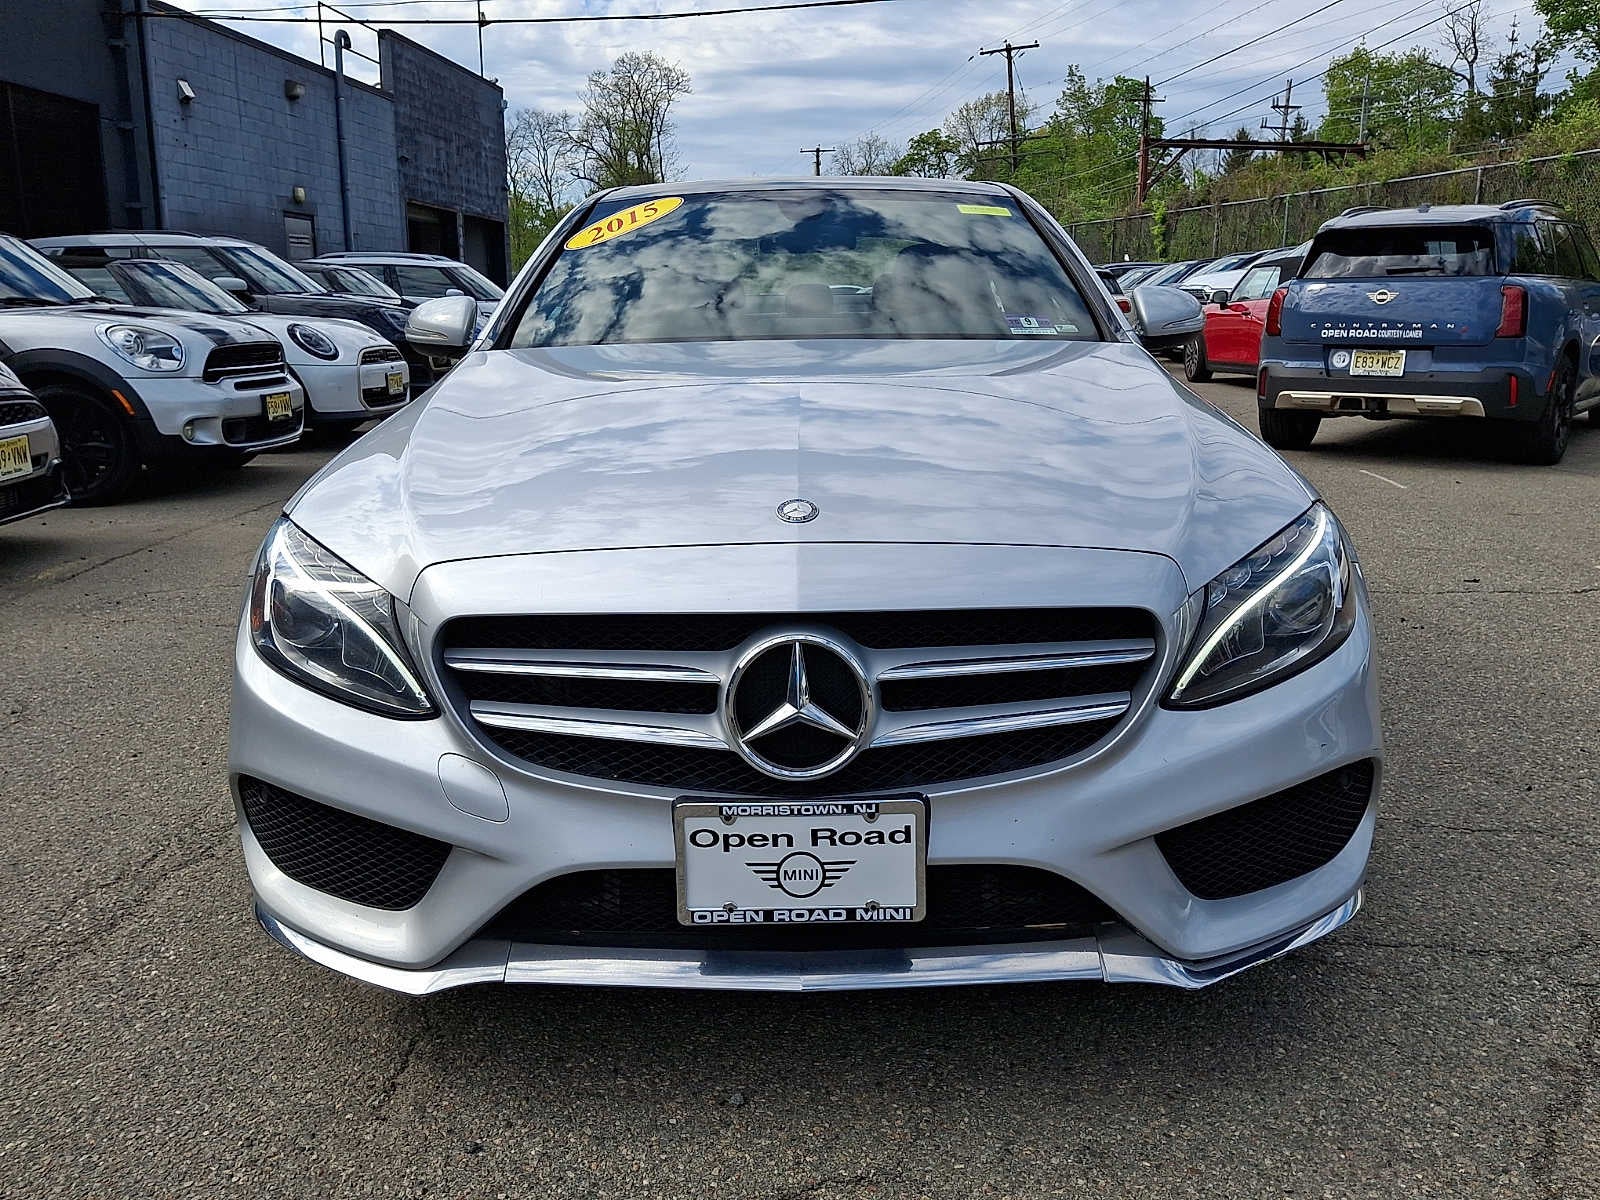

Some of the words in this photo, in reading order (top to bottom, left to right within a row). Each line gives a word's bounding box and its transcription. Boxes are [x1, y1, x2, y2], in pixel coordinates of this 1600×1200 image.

[588, 203, 658, 243] 2015
[1321, 329, 1348, 338] OPEN
[1349, 329, 1378, 338] ROAD
[1378, 330, 1403, 338] COURTESY
[1403, 330, 1423, 339] LOANER
[722, 804, 847, 816] MORRISTOWN,
[853, 803, 877, 814] NJ
[689, 828, 794, 853] Open
[810, 825, 912, 847] Road
[783, 868, 819, 881] MINI
[693, 909, 764, 924] OPEN
[773, 909, 847, 922] ROAD
[856, 908, 911, 921] MINI
